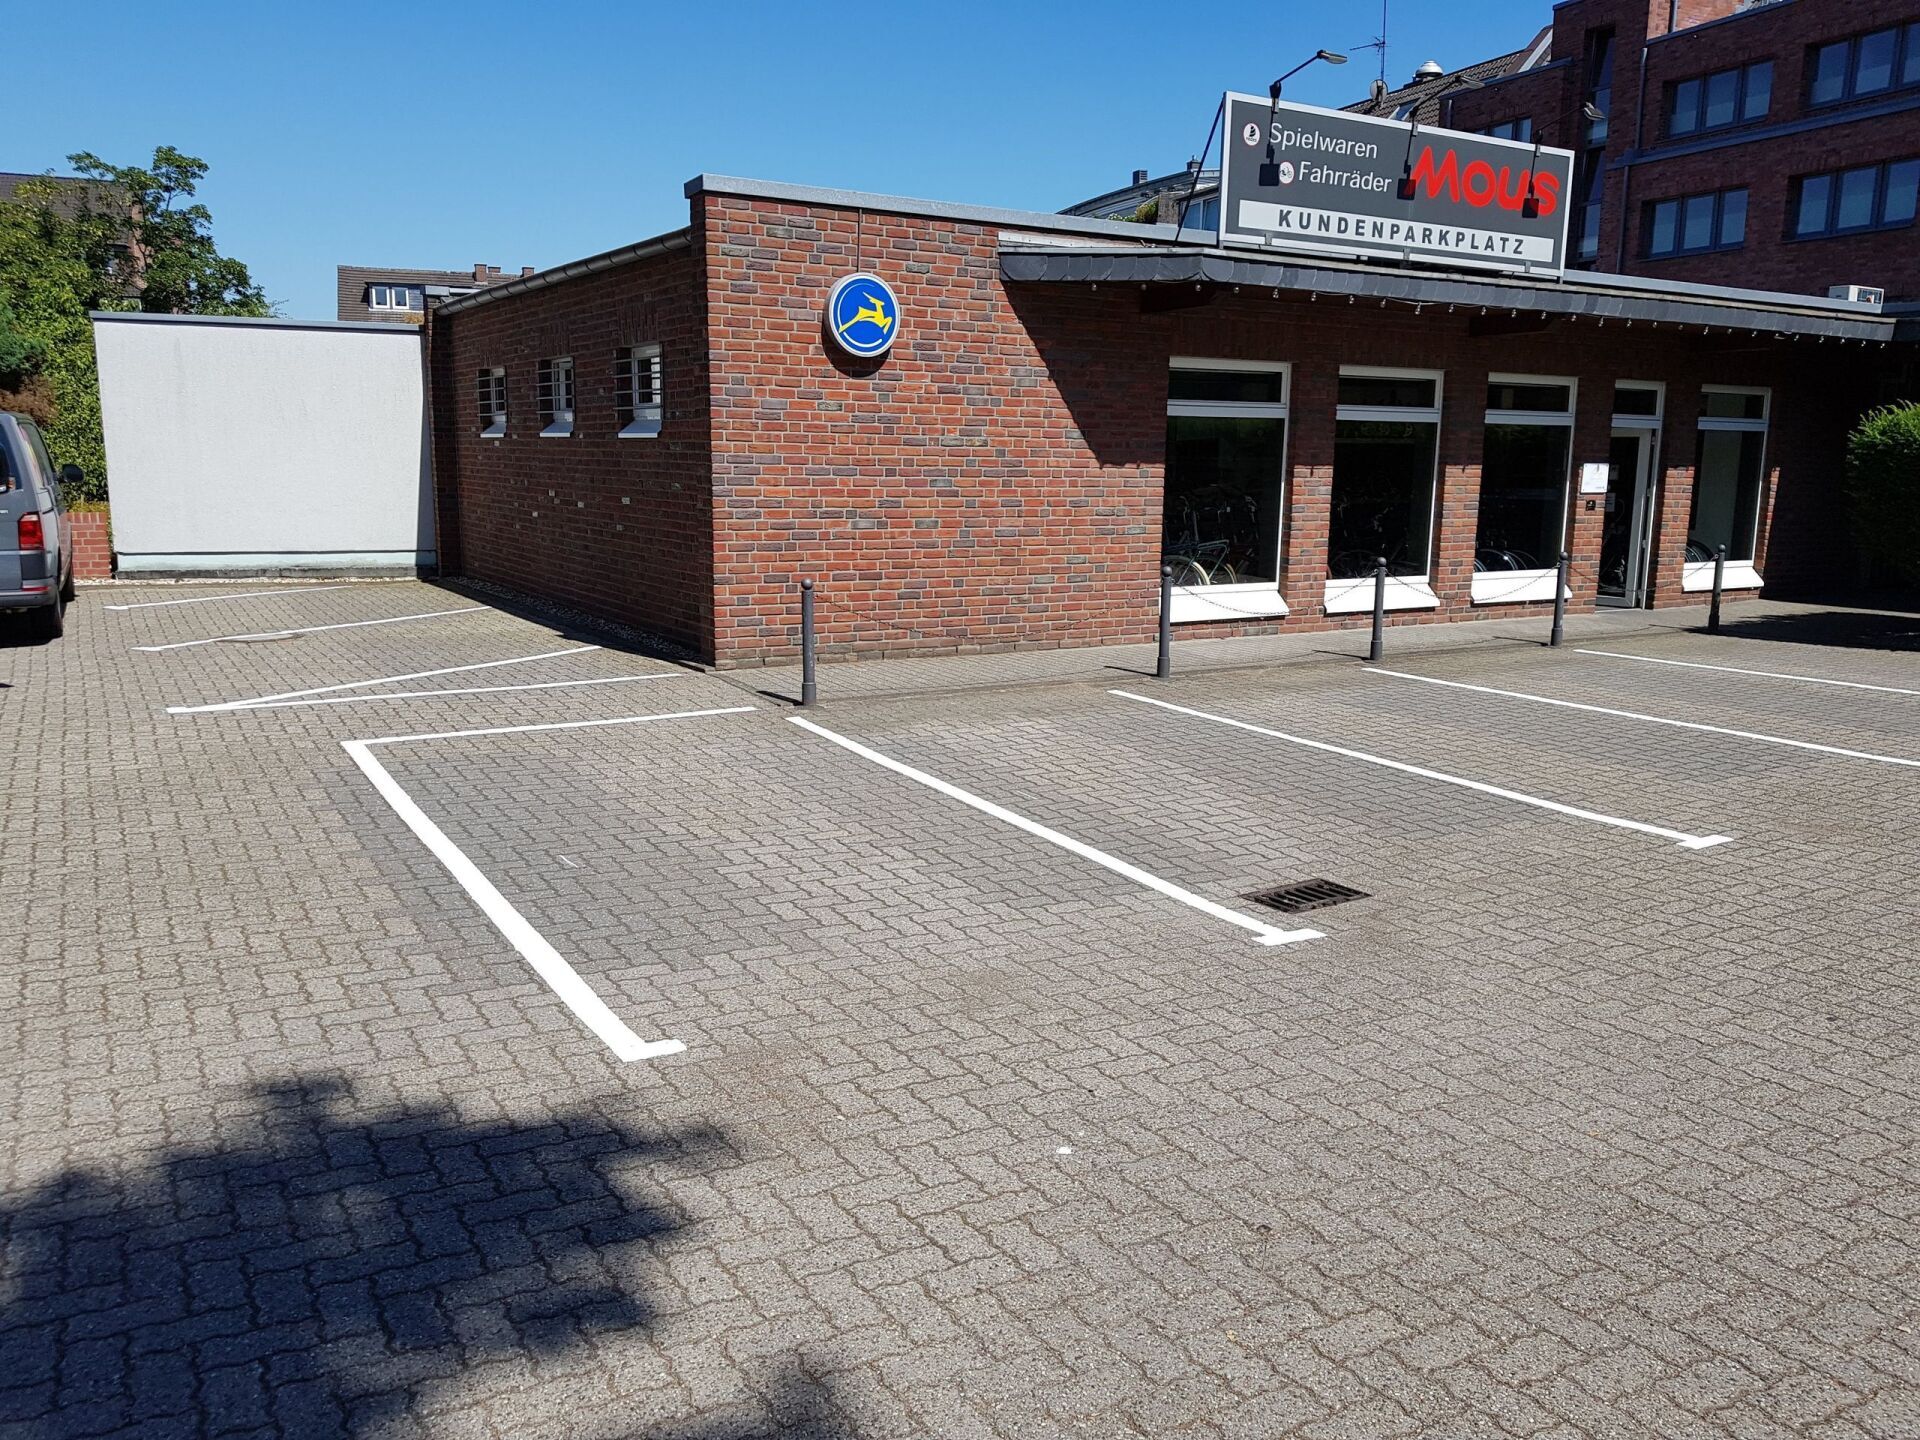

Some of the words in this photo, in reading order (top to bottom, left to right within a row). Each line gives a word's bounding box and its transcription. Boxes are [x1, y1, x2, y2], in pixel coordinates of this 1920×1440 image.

[1270, 123, 1377, 158] Spielwaren
[1298, 161, 1392, 192] Fahrräder
[1278, 209, 1524, 255] KUNDENPARKPLATZ
